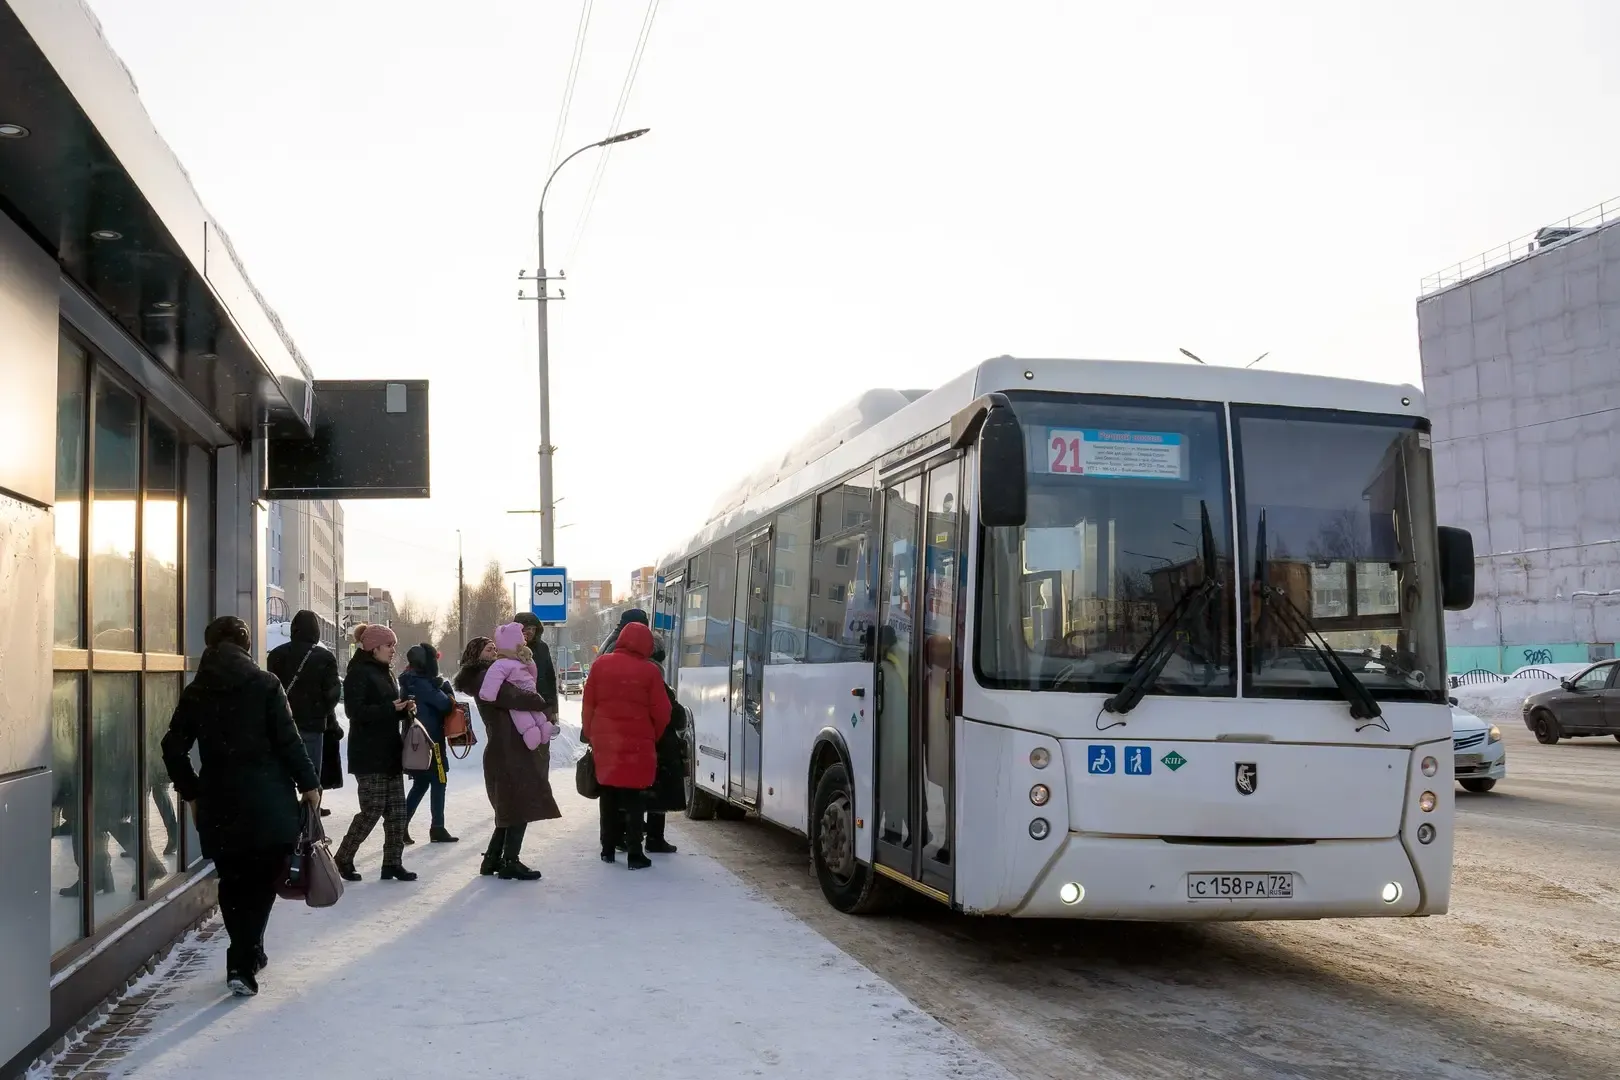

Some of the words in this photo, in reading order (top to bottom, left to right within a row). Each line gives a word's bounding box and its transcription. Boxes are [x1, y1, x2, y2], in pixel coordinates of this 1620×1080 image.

[1052, 437, 1083, 473] 21
[1165, 757, 1183, 765] КПГ
[1269, 875, 1286, 890] 72
